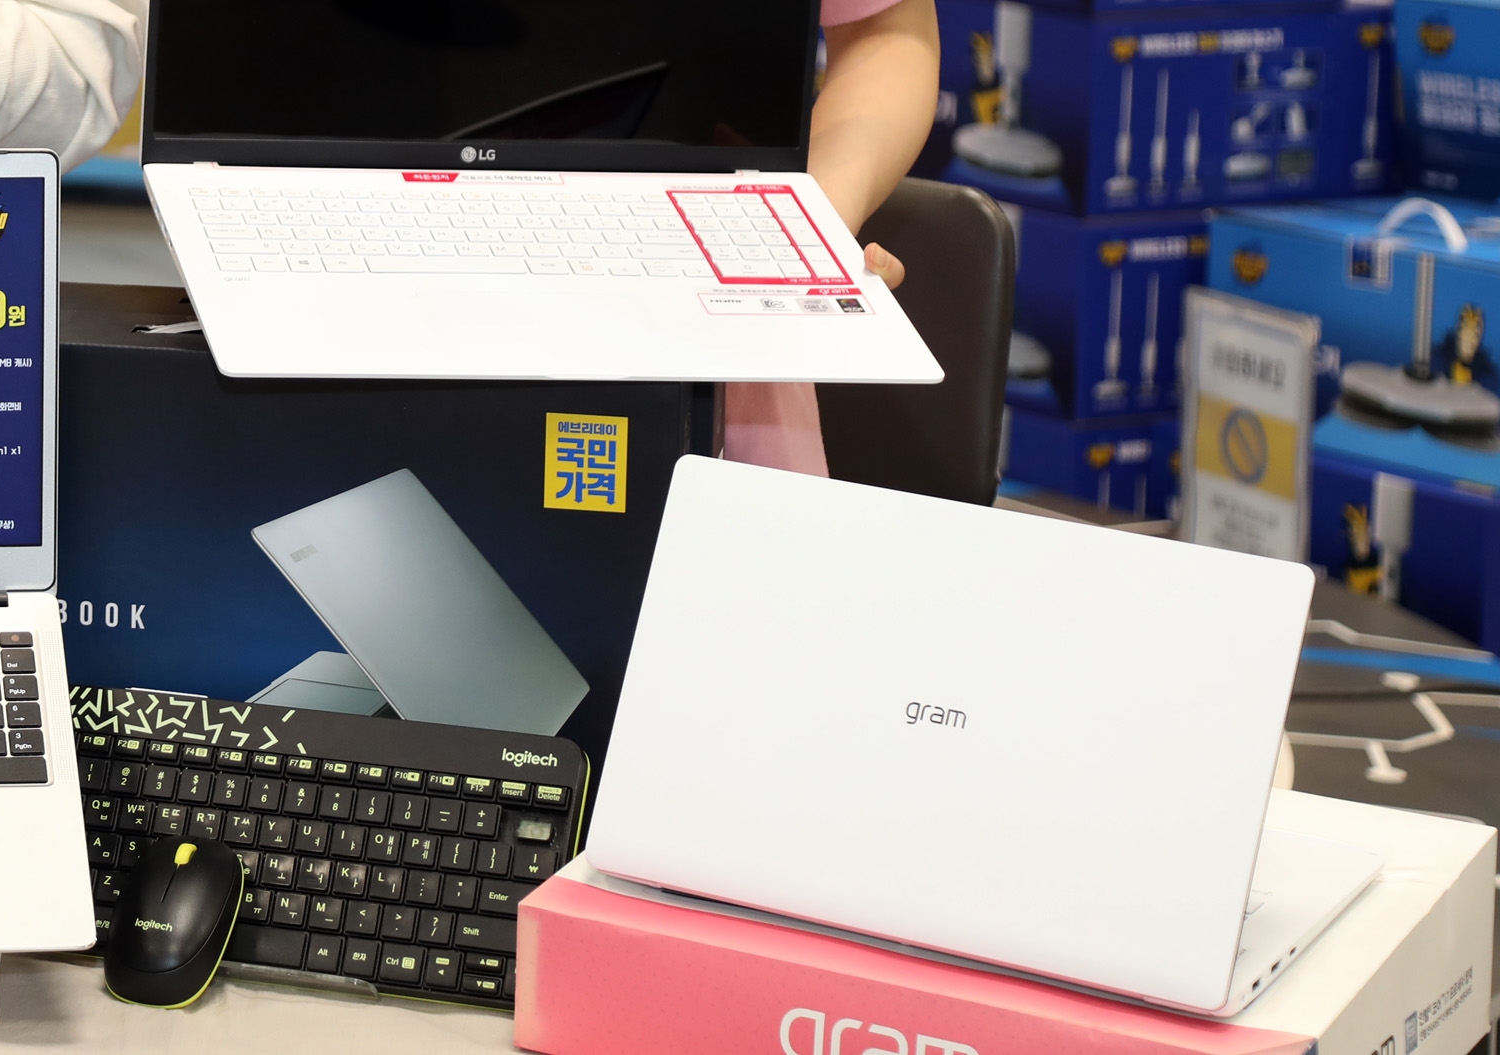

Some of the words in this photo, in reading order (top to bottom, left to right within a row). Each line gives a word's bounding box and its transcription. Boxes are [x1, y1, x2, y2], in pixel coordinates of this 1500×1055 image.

[478, 148, 496, 161] LG
[557, 421, 618, 436] 에브리데이
[555, 438, 617, 470] 국민
[555, 472, 617, 505] 가격
[905, 700, 967, 730] gram
[502, 748, 558, 767] logitech
[502, 788, 523, 797] Insert
[537, 792, 561, 801] Delete
[488, 891, 509, 902] Enter
[134, 918, 173, 933] logitech
